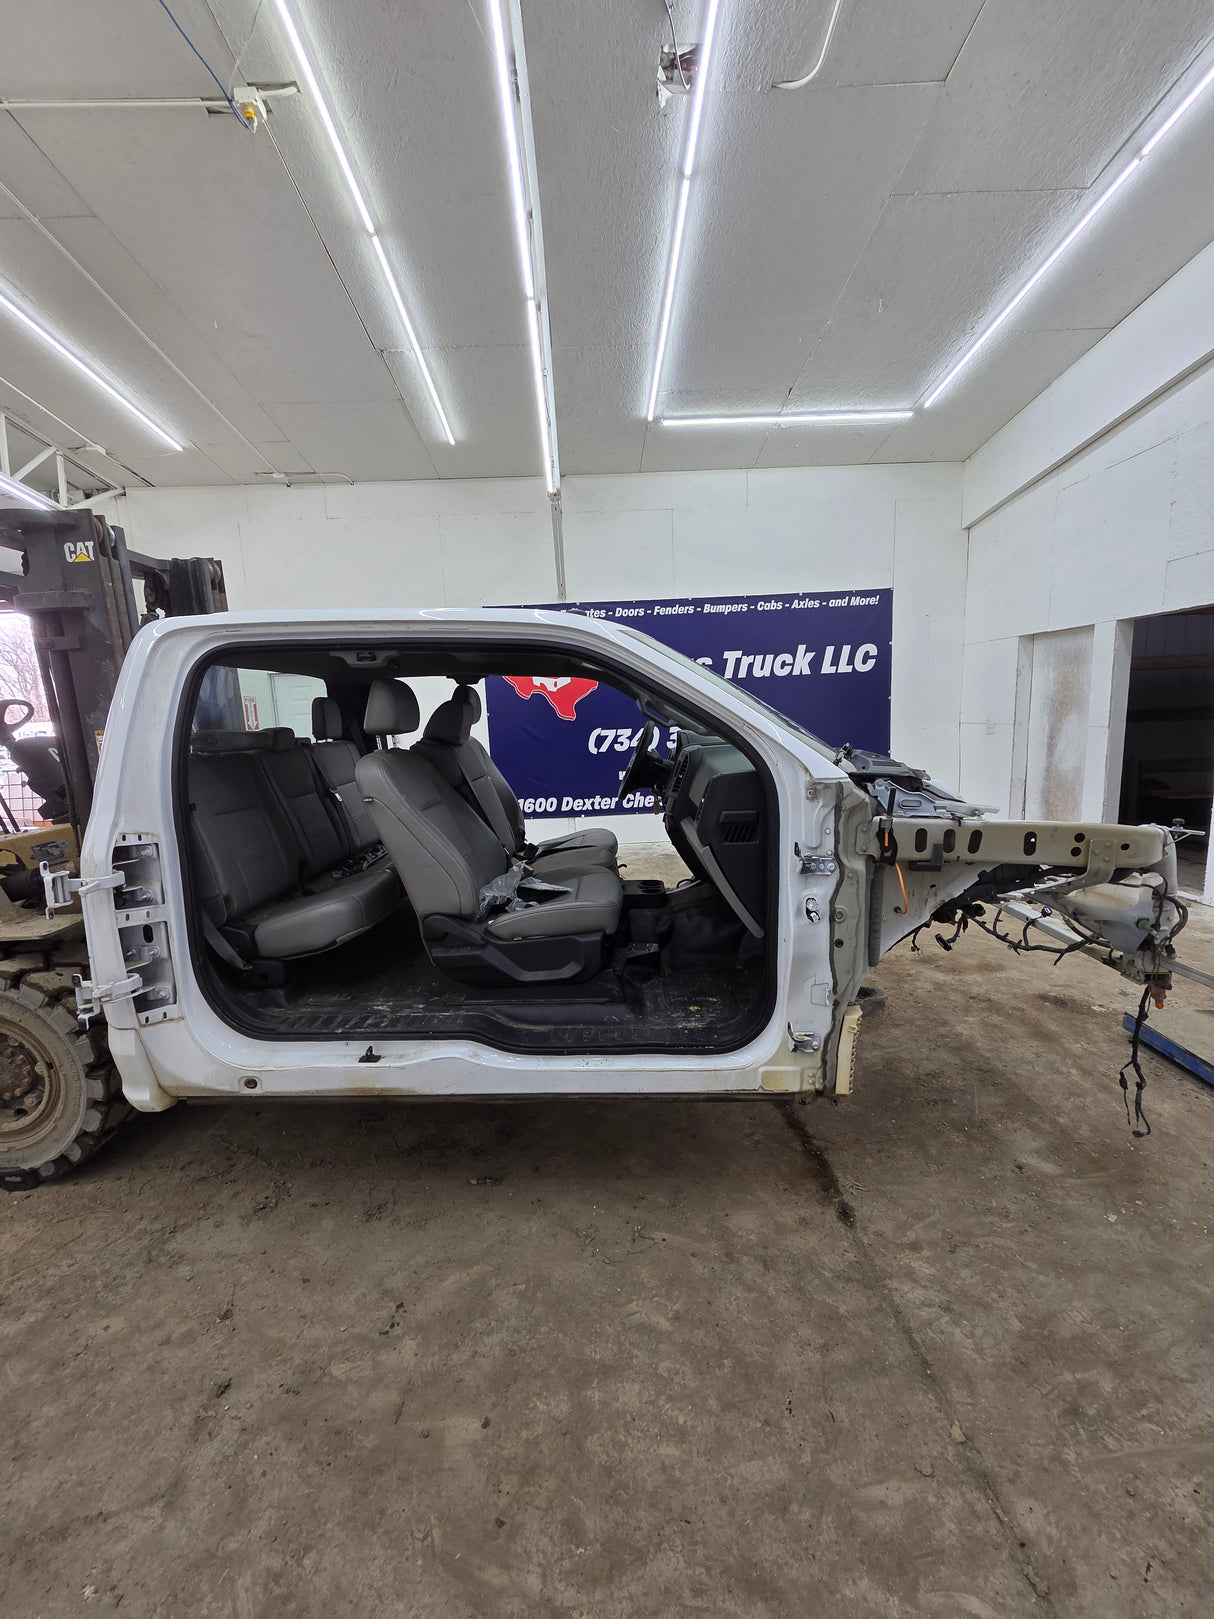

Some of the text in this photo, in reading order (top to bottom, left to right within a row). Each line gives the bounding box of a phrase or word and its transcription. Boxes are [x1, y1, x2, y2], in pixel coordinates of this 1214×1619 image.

[63, 540, 95, 563] CAT
[615, 607, 645, 617] Doors
[653, 604, 694, 616] Fenders
[703, 603, 749, 615] Bumpers
[756, 600, 784, 611] Cabs
[791, 597, 821, 609] Axles
[828, 596, 849, 607] and
[850, 595, 881, 606] More!
[722, 644, 816, 679] Truck
[820, 643, 878, 674] LLC
[561, 795, 619, 812] Dexter
